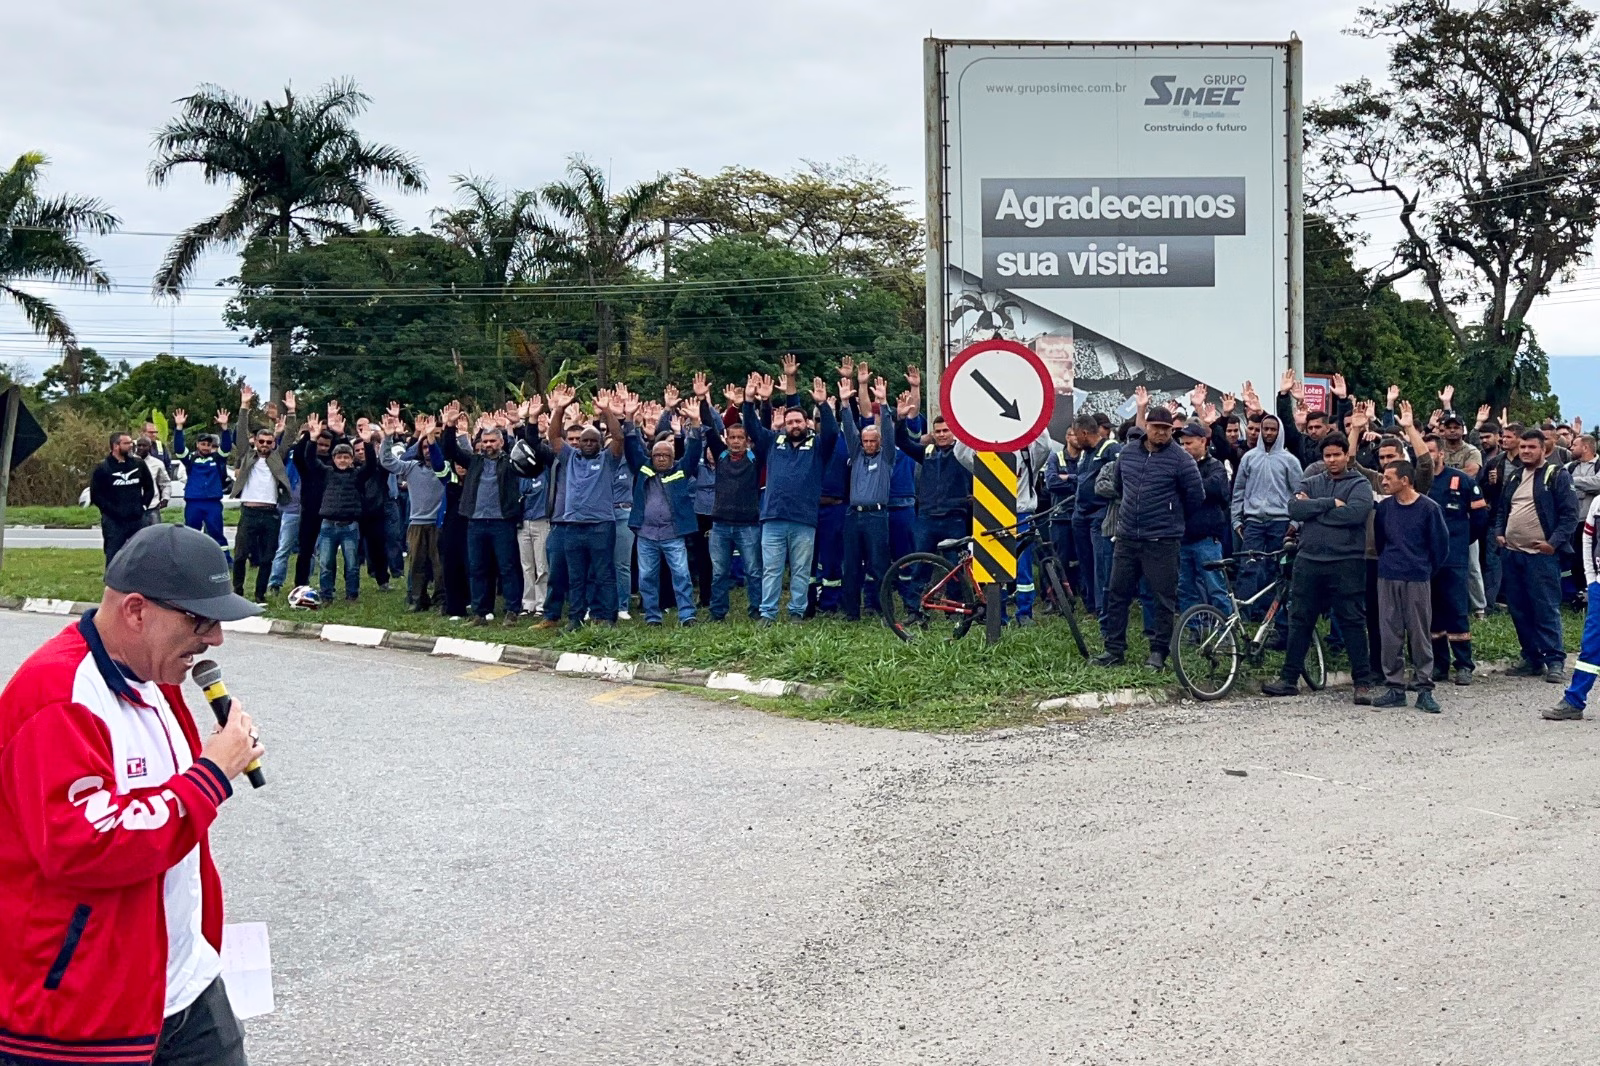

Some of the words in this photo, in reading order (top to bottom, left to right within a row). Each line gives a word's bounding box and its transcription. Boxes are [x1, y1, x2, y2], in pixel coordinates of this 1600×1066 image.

[1203, 74, 1247, 85] GRUPO
[985, 82, 1127, 95] www.gruposimec.com.br
[1144, 75, 1245, 106] SIMEC
[1144, 122, 1204, 132] Construindo
[1206, 124, 1213, 132] o
[1216, 122, 1247, 132] futuro
[995, 186, 1236, 229] Agradecemos
[996, 251, 1059, 276] sua
[1068, 243, 1168, 276] visita!
[1304, 386, 1323, 395] Lotes
